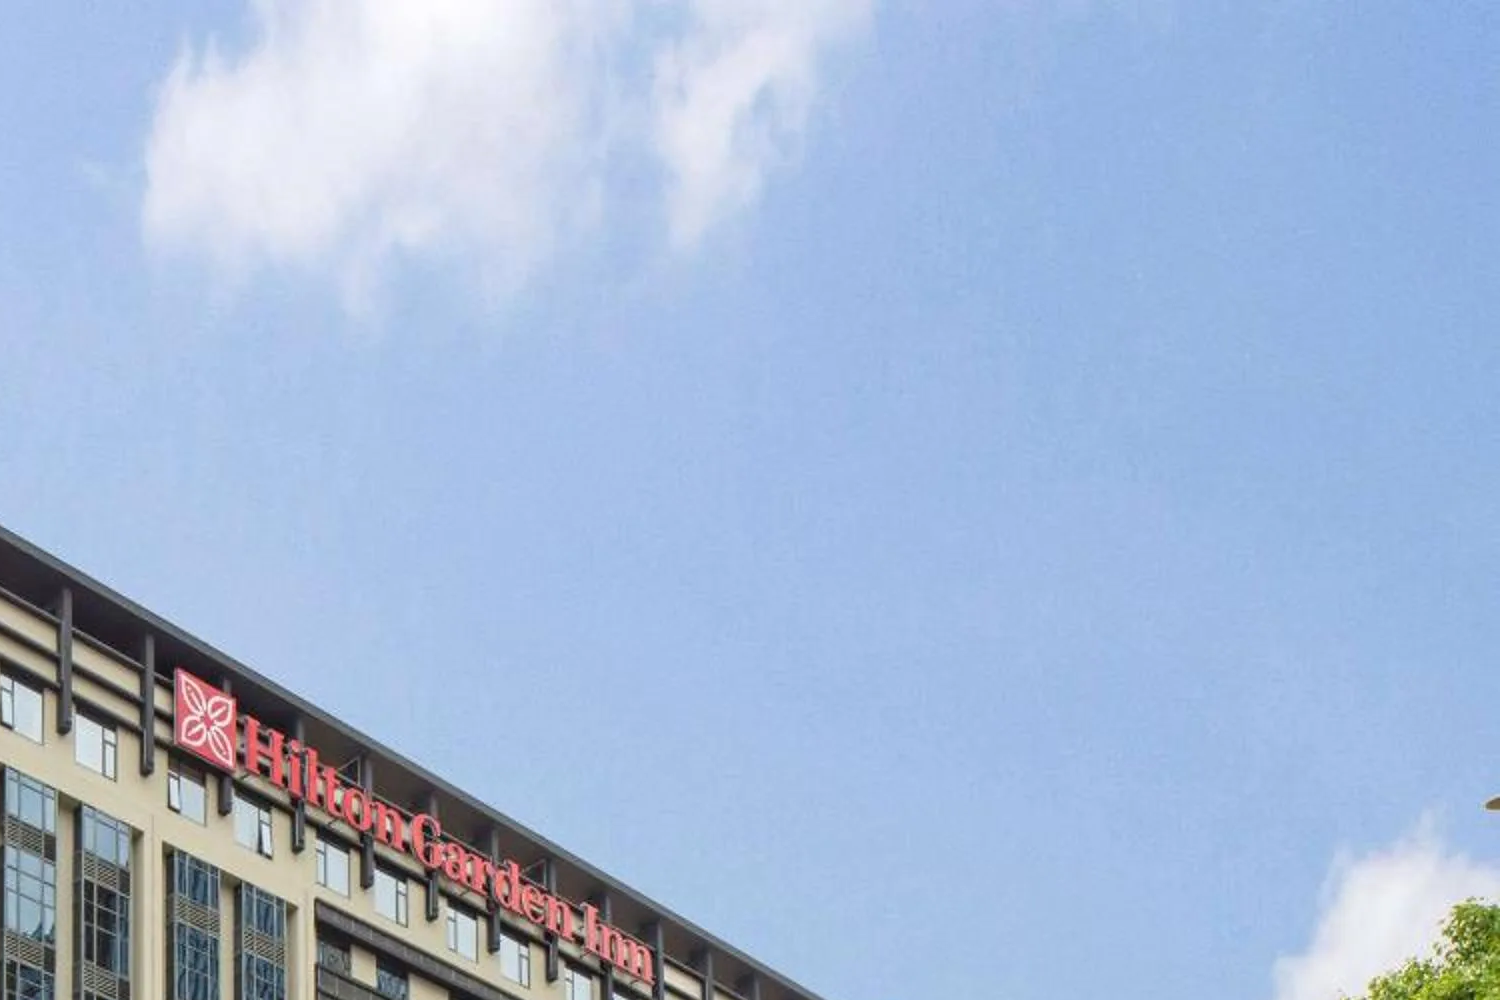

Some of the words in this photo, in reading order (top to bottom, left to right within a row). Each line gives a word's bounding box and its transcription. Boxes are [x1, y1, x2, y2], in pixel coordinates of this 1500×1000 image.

[243, 715, 405, 851] Hilton
[411, 813, 573, 942] Garden
[580, 902, 655, 985] Inn
